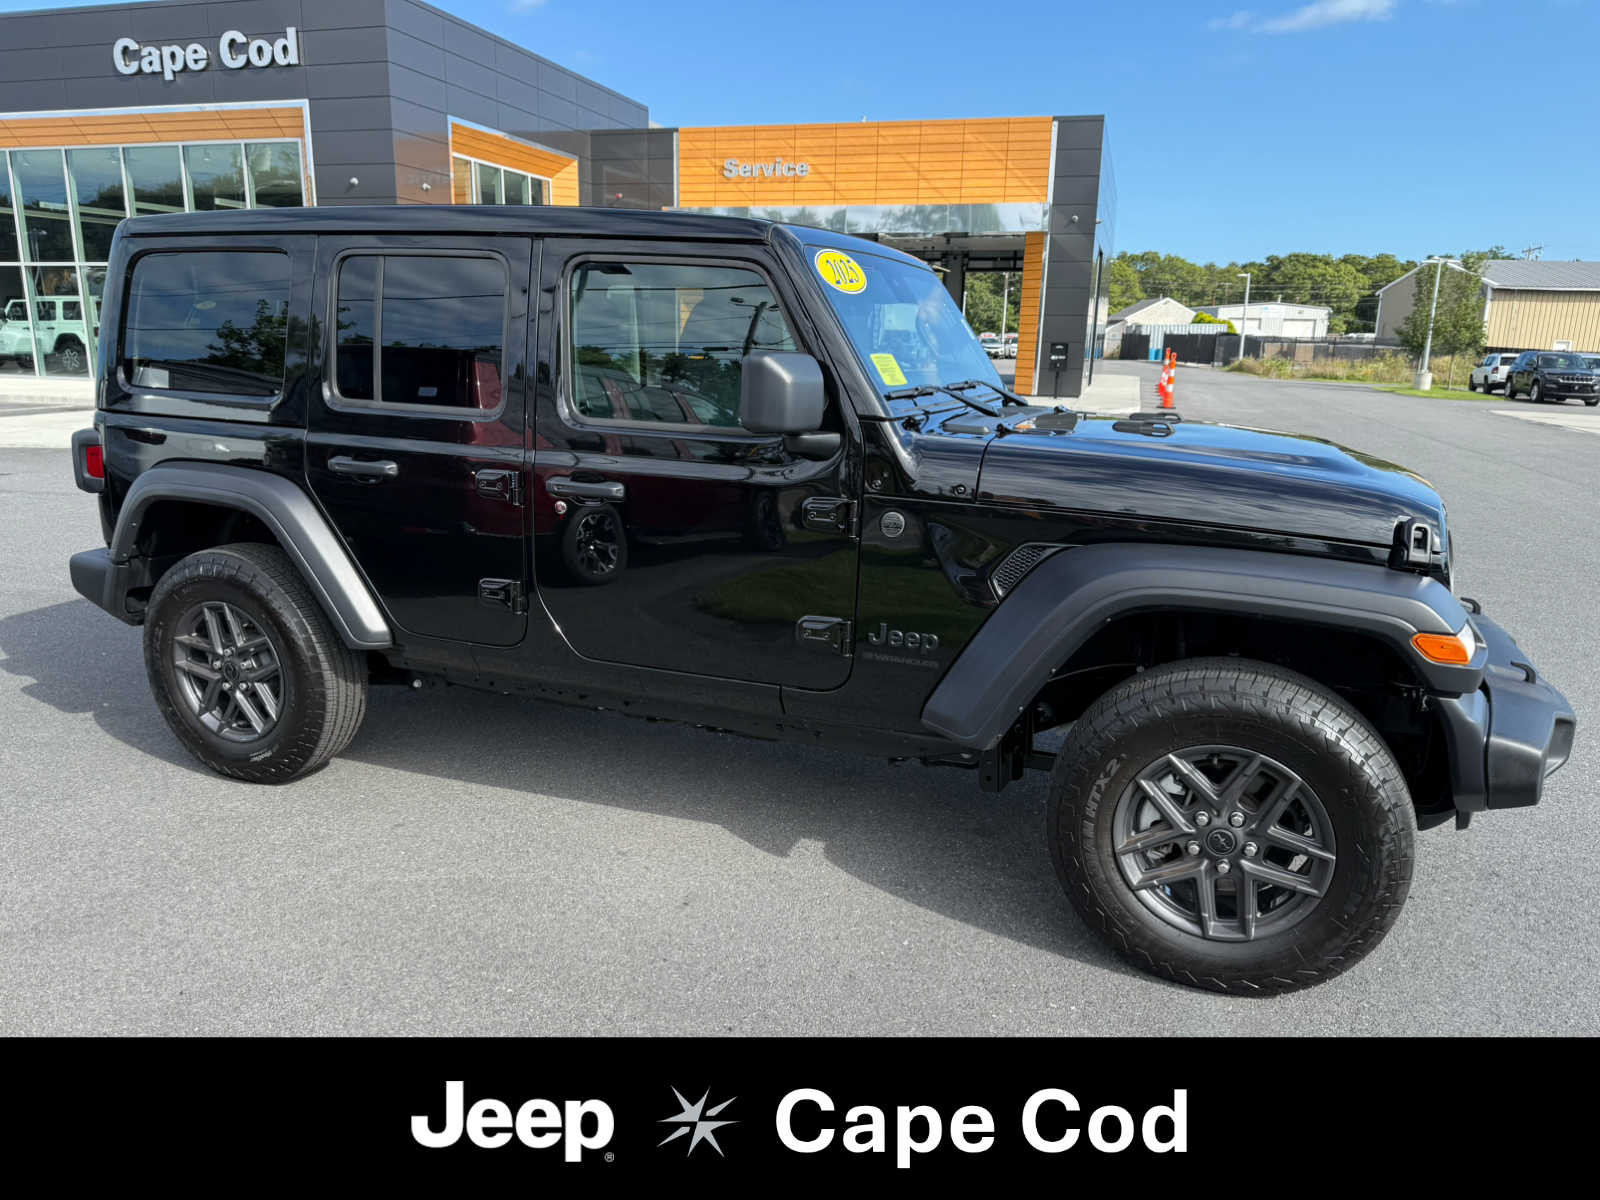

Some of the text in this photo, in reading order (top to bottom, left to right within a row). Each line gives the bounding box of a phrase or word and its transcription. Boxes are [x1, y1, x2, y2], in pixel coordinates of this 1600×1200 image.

[113, 26, 299, 81] Cape Cod
[723, 157, 809, 178] Service
[826, 259, 859, 285] 2025
[868, 622, 938, 655] Jeep
